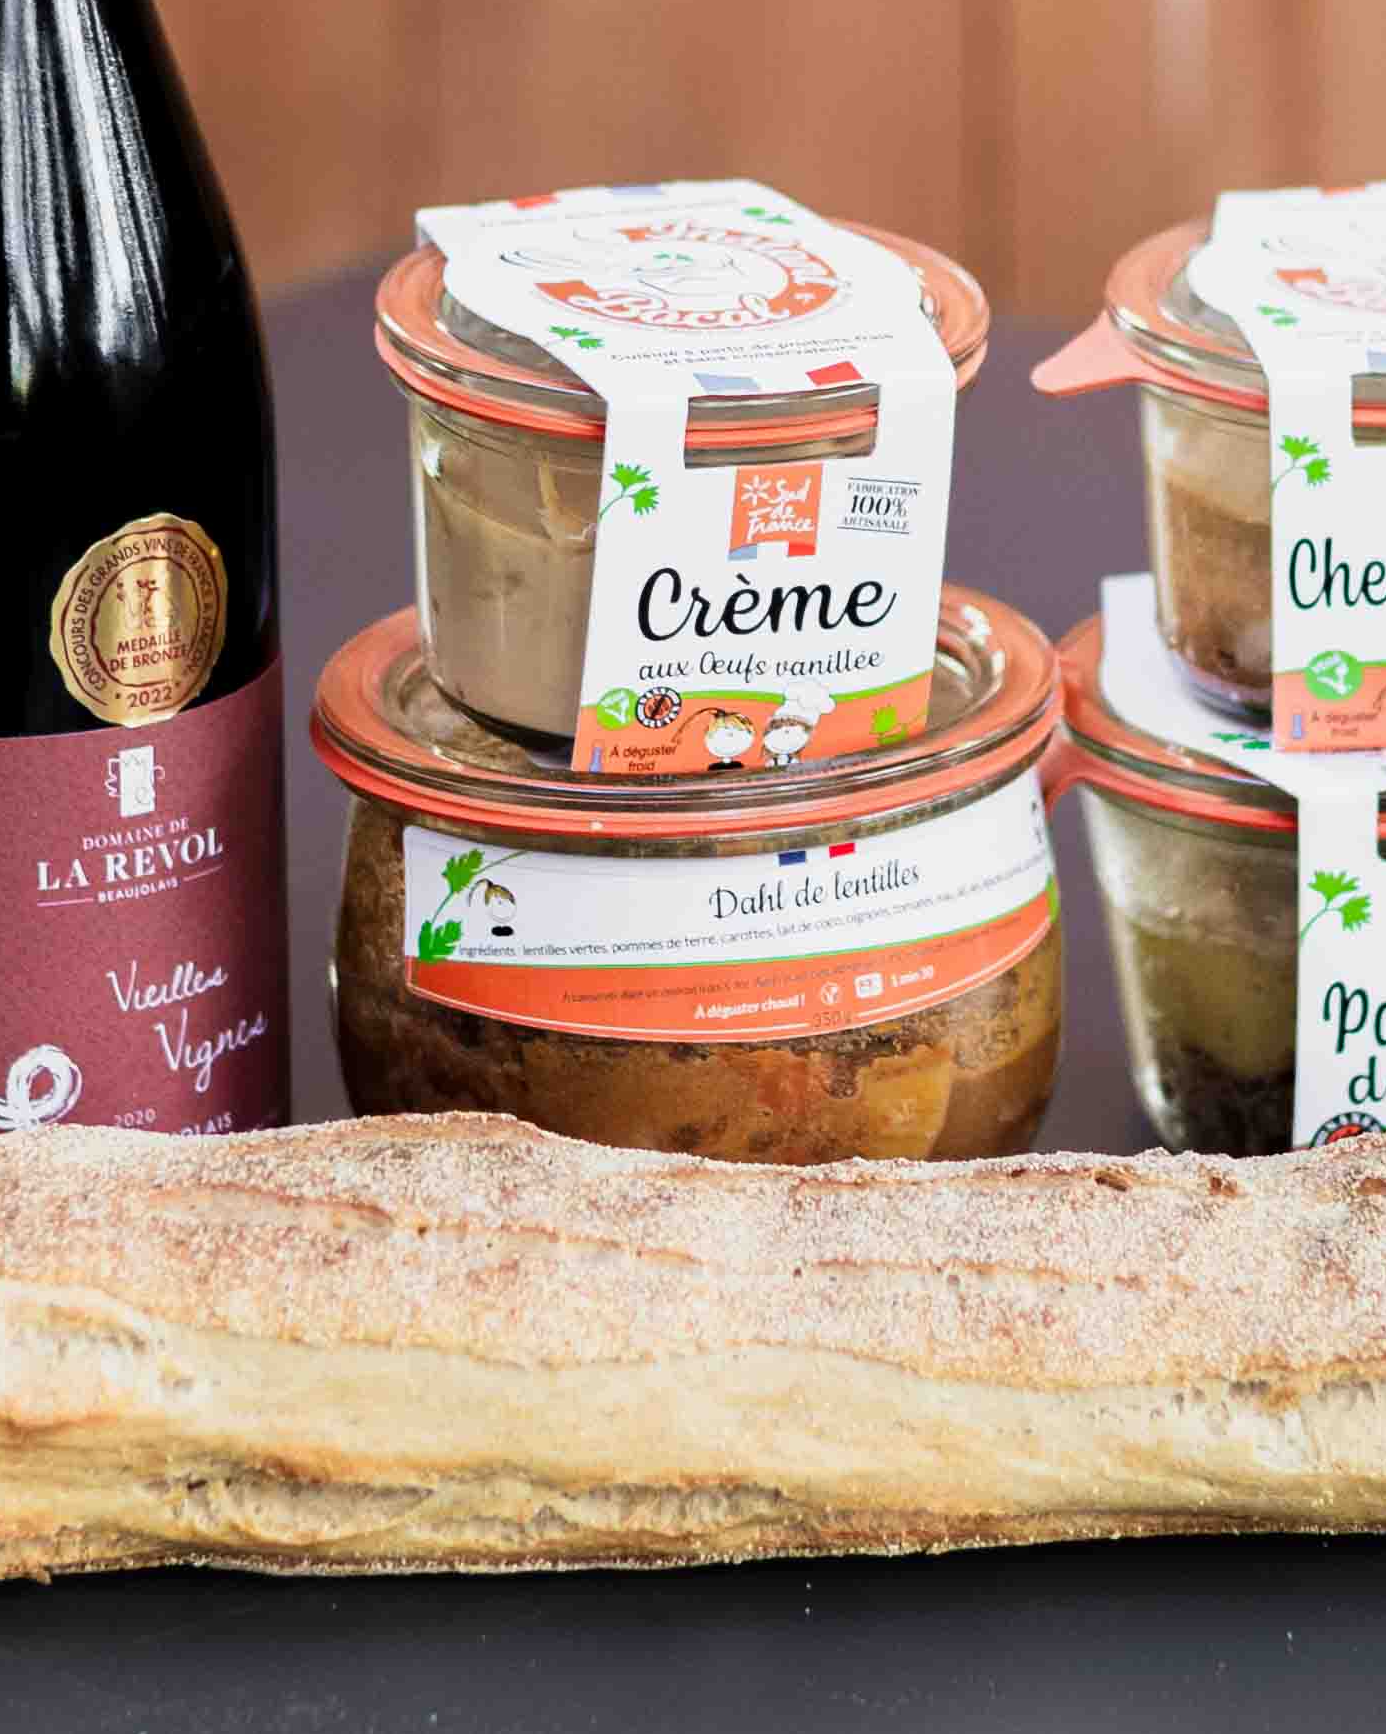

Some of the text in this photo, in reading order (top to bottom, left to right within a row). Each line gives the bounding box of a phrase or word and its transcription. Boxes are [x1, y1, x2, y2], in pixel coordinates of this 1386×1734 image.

[769, 475, 811, 506] Sud
[850, 494, 908, 518] 100%
[747, 506, 814, 543] France
[770, 503, 795, 519] de
[89, 543, 141, 586] GRANDS
[75, 588, 95, 614] DES
[638, 567, 897, 641] Crème
[70, 617, 108, 692] CONCOURS
[110, 643, 185, 673] DE BRONZE
[639, 660, 690, 681] aux
[775, 648, 882, 677] vanillée
[127, 685, 173, 708] 2022
[82, 817, 190, 851] DOMAINE DE
[37, 826, 224, 891] LA REVOL
[97, 876, 179, 903] BEAUJOLAIS
[709, 882, 785, 919] Dahl
[794, 875, 825, 908] de
[833, 858, 921, 902] lentilles
[523, 943, 567, 957] lentilles
[612, 939, 663, 954] pommes
[666, 937, 681, 949] de
[106, 959, 230, 1012] Vieilles
[154, 1007, 268, 1093] Vignes
